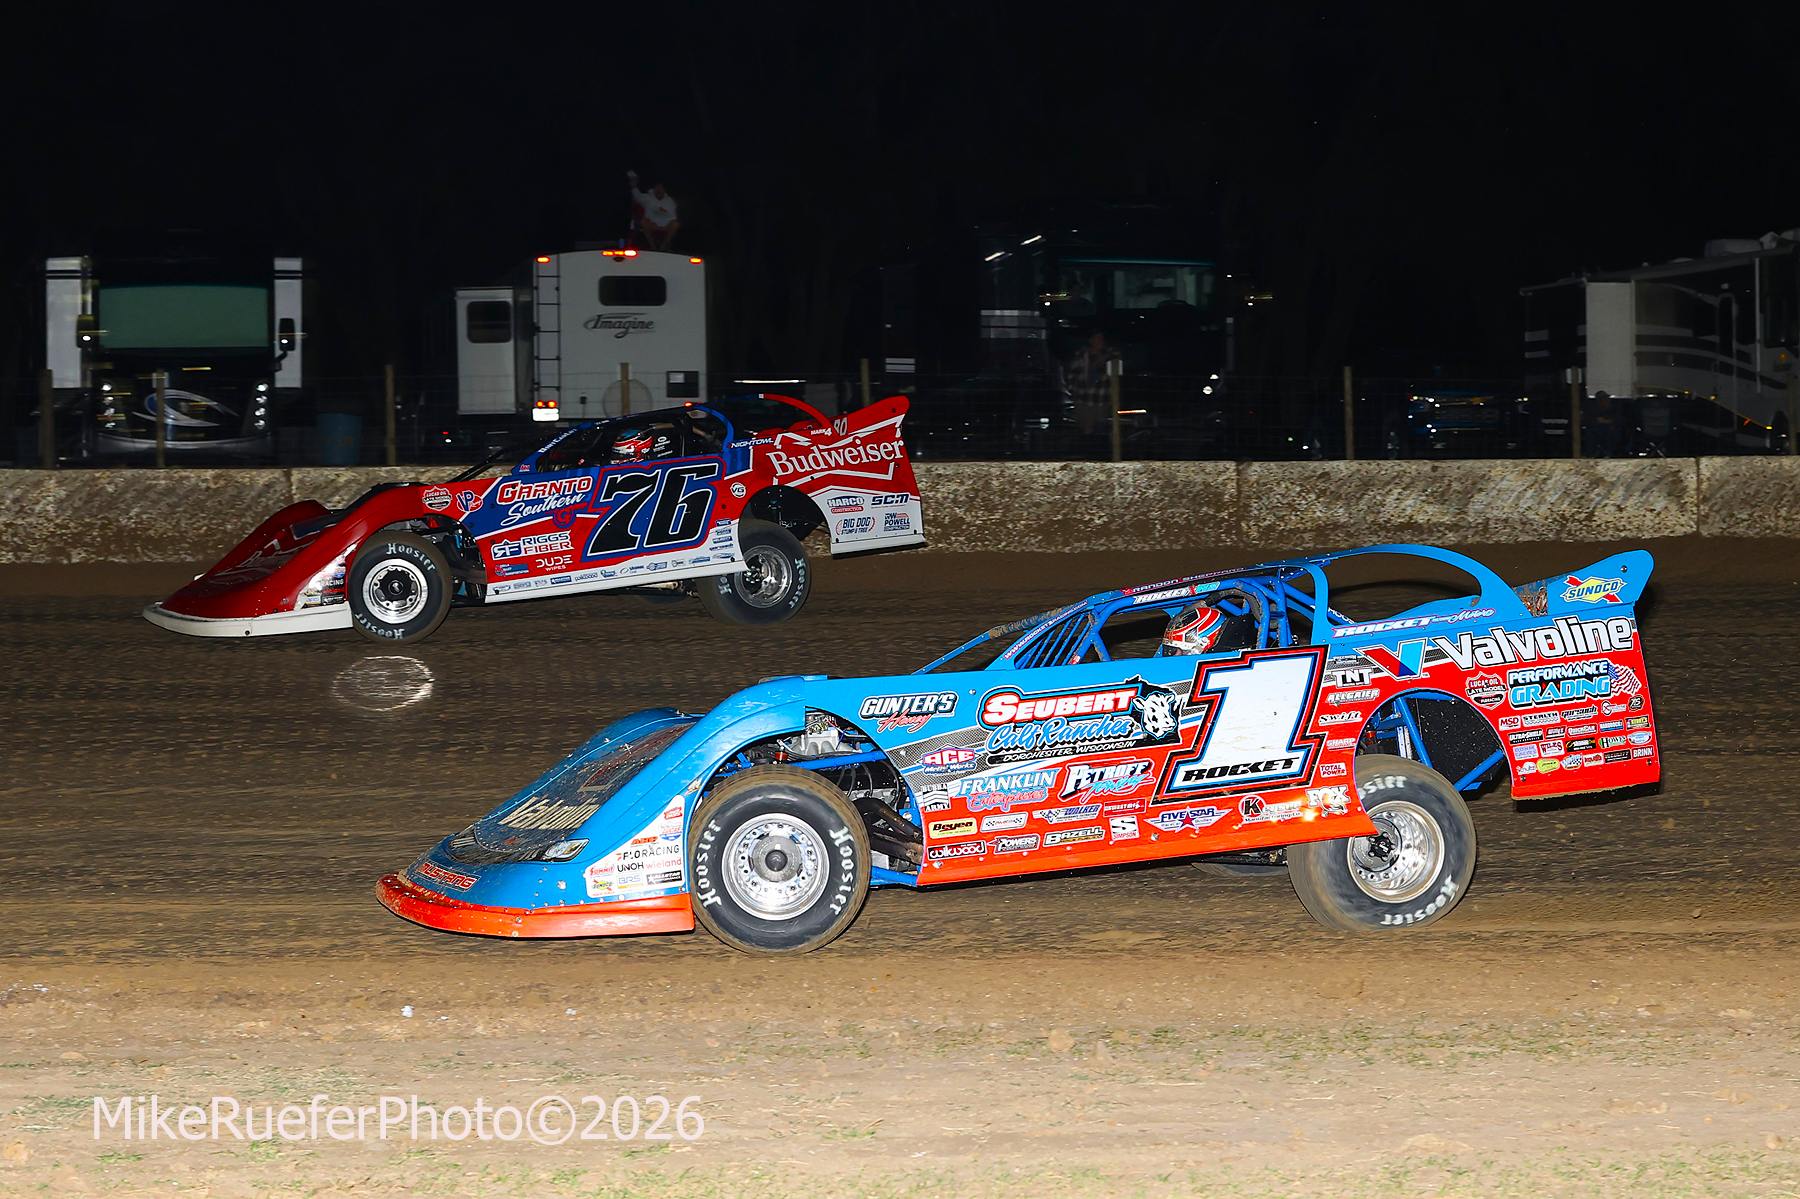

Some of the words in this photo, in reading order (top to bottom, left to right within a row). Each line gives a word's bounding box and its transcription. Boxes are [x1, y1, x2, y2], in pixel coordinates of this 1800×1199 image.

[583, 313, 656, 339] Imagine
[766, 439, 904, 477] Budweiser
[497, 476, 593, 506] GARNTO
[500, 492, 586, 527] Southern
[586, 461, 720, 557] 76
[842, 518, 855, 528] BIG
[856, 516, 871, 527] DOG
[885, 518, 910, 527] POWELL
[522, 532, 570, 546] RIGGS
[524, 541, 573, 555] FIBER
[386, 543, 436, 571] Hoosier
[536, 554, 574, 568] DUDE
[1569, 581, 1619, 599] SUNOCO
[1334, 616, 1434, 638] ROCKET
[1433, 616, 1634, 670] Valvoline
[1332, 668, 1372, 688] TNT
[1508, 661, 1609, 685] PERFORMANCE
[1511, 675, 1611, 706] GRADING
[861, 692, 956, 718] GUNTER'S
[984, 689, 1136, 725] SEUBERT
[987, 722, 1041, 751] Calf
[1040, 714, 1130, 746] Ranches
[1173, 656, 1314, 789] 1
[1500, 717, 1519, 726] MSD
[1076, 740, 1136, 754] WISCONSIN
[1633, 747, 1653, 758] BRINN
[1182, 756, 1300, 782] ROCKET
[960, 769, 1056, 796] FRANKLIN
[1160, 812, 1187, 823] FIVE
[1187, 807, 1216, 818] STAR
[1045, 827, 1104, 846] BAZELL
[929, 841, 985, 859] wilwood
[419, 862, 478, 890] MUSTANG
[616, 862, 645, 873] UNOH
[696, 819, 723, 908] Hoosier
[829, 825, 856, 916] Hoosier
